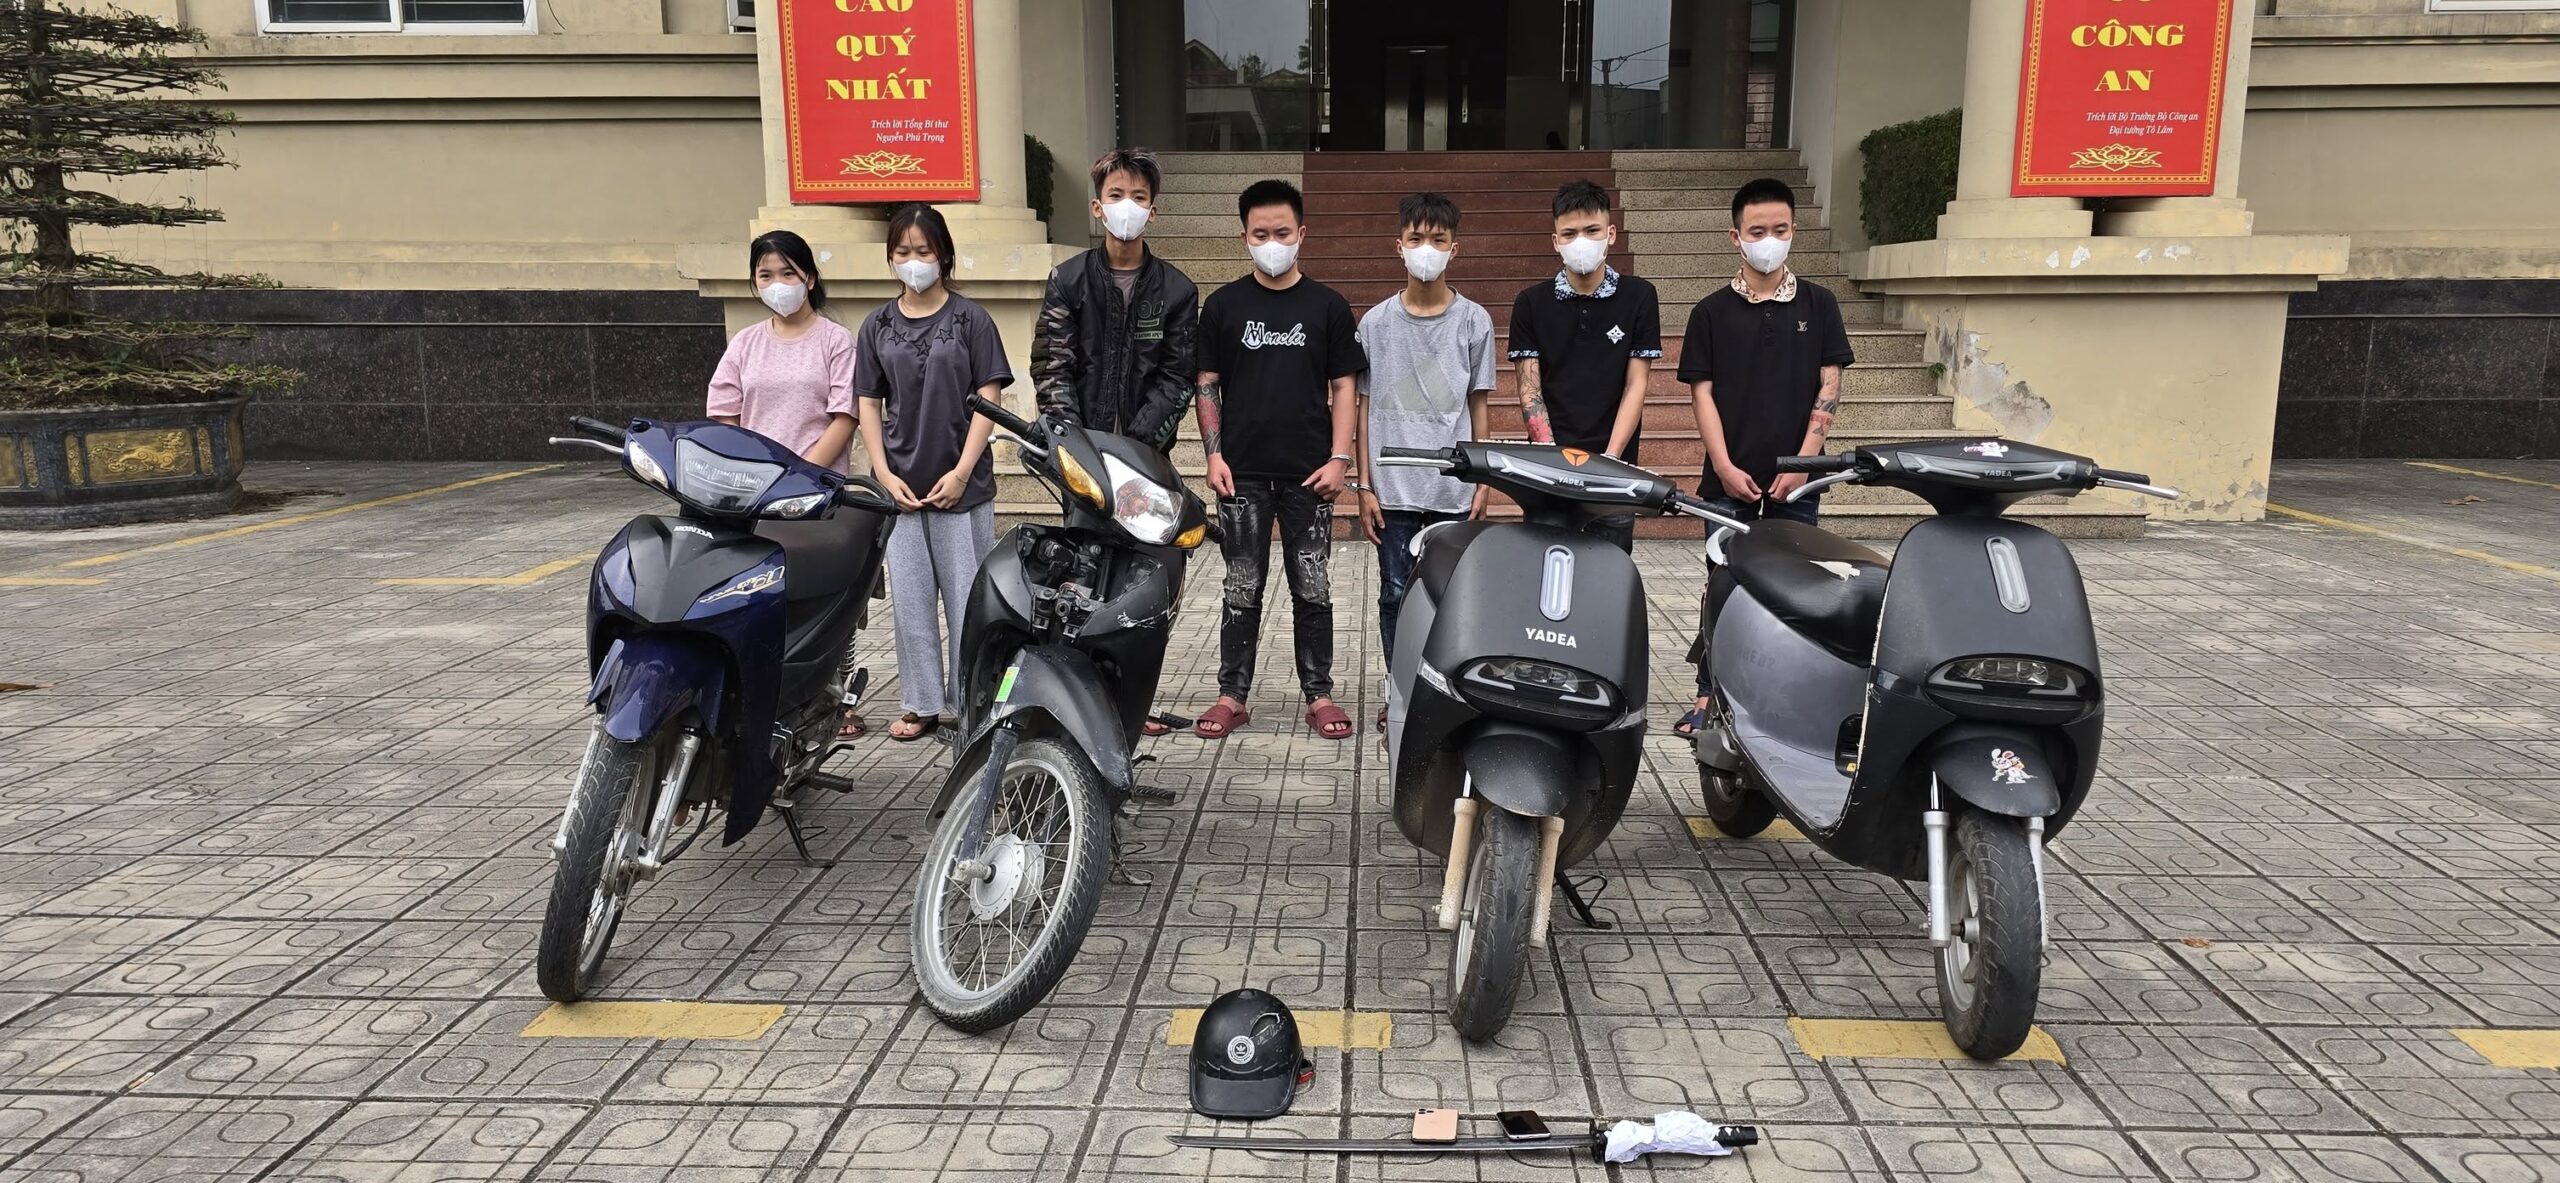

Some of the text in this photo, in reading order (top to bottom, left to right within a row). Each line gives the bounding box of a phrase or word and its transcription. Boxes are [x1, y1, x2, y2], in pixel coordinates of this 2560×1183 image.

[834, 0, 914, 13] CAO
[2070, 18, 2186, 47] CÔNG
[835, 27, 916, 62] QUÝ
[825, 67, 932, 100] NHẤT
[2093, 69, 2154, 92] AN
[871, 119, 891, 129] Trích
[904, 118, 923, 130] Tổng
[924, 119, 934, 129] Bí
[935, 119, 949, 129] thư
[2087, 112, 2106, 121] Trích
[2168, 112, 2188, 122] Công
[2188, 113, 2199, 121] an
[922, 132, 945, 143] Trọng
[1983, 469, 2012, 477] YADEA
[1558, 475, 1585, 487] YADEA
[673, 525, 715, 540] HONDA
[1525, 627, 1577, 648] YADEA
